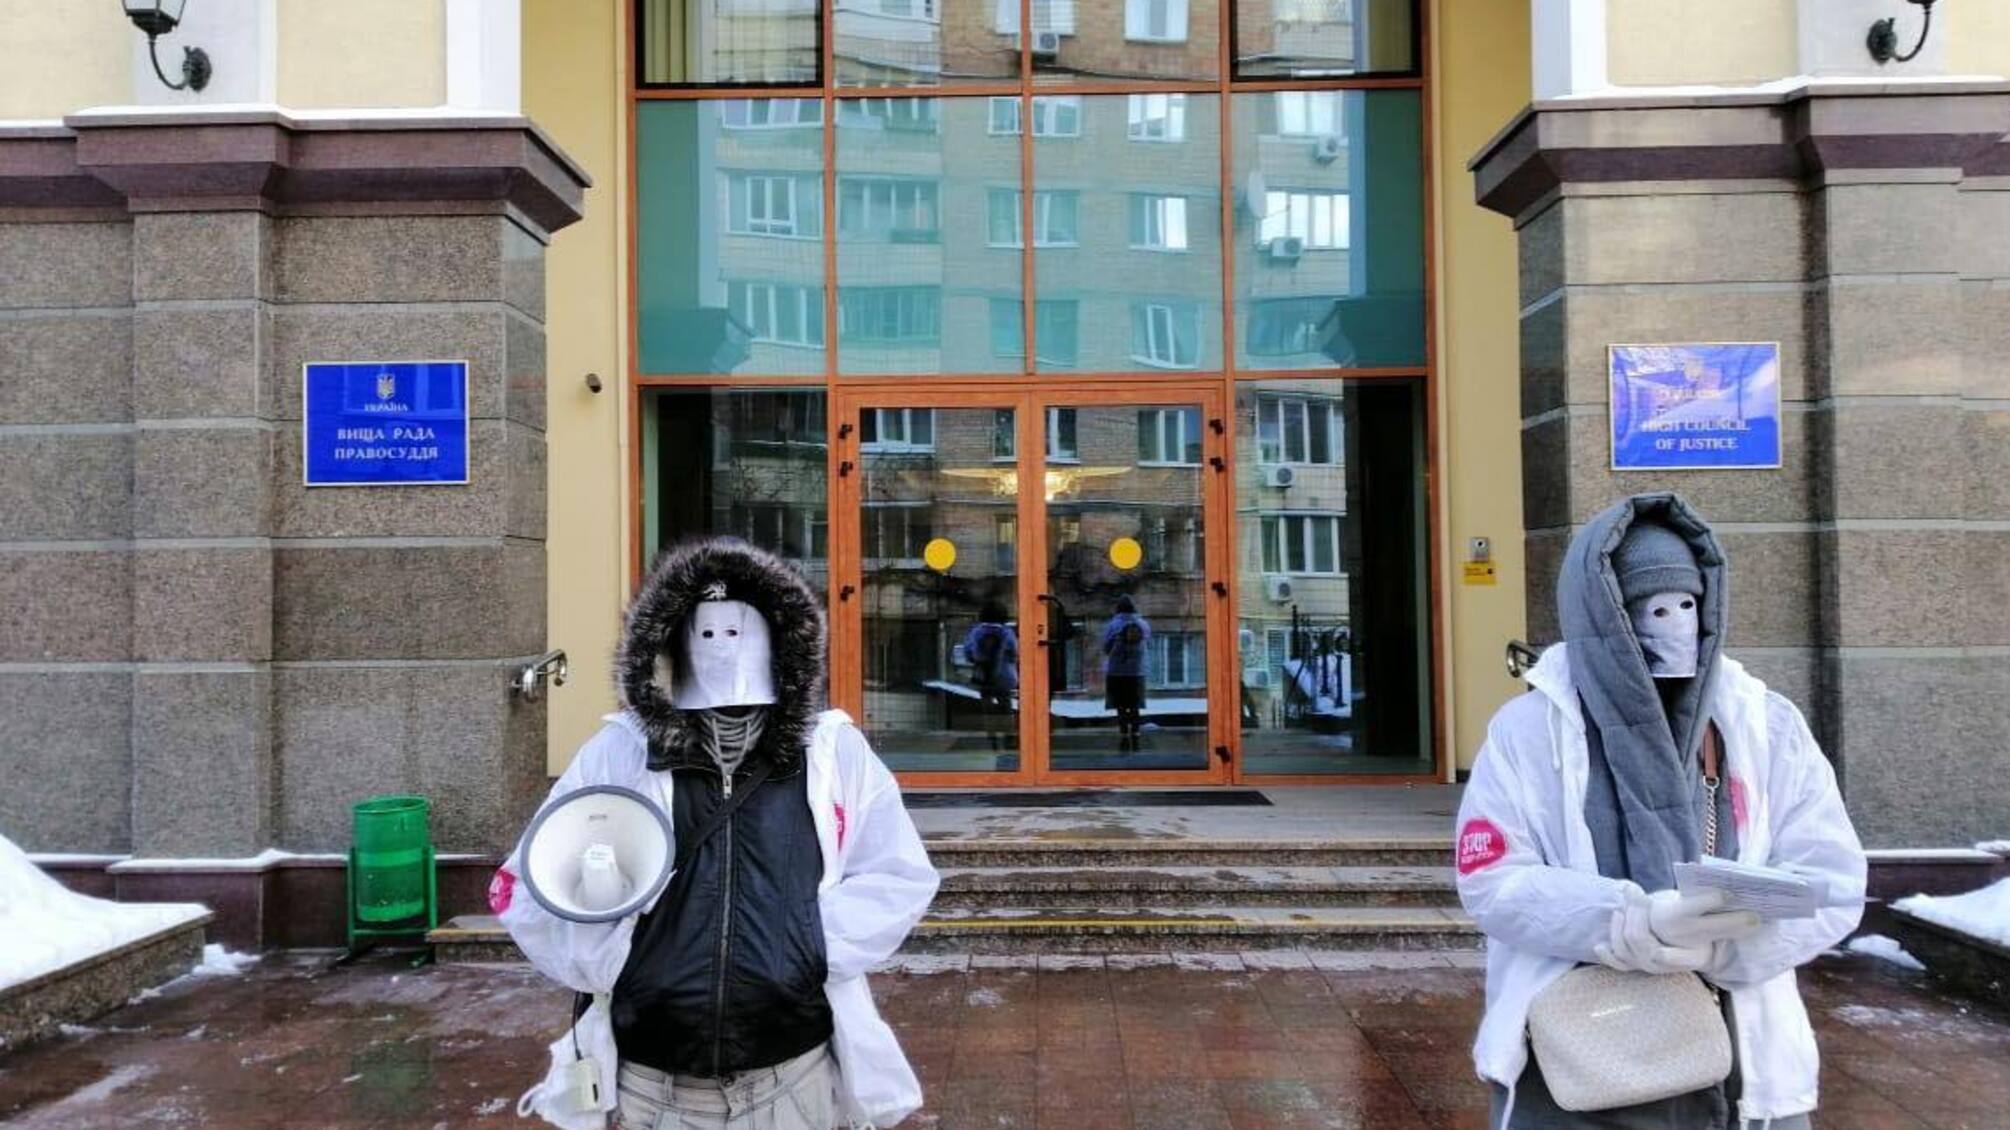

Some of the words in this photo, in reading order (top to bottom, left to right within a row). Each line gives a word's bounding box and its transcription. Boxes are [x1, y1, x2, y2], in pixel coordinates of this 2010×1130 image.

[364, 402, 409, 412] УКРАЇНА
[337, 428, 385, 442] ВИЩА
[393, 428, 435, 441] РАДА
[1656, 438, 1676, 450] OF
[1679, 438, 1739, 451] JUSTICE
[334, 446, 439, 460] ПРАВОСУДДЯ
[1462, 832, 1492, 855] STOP
